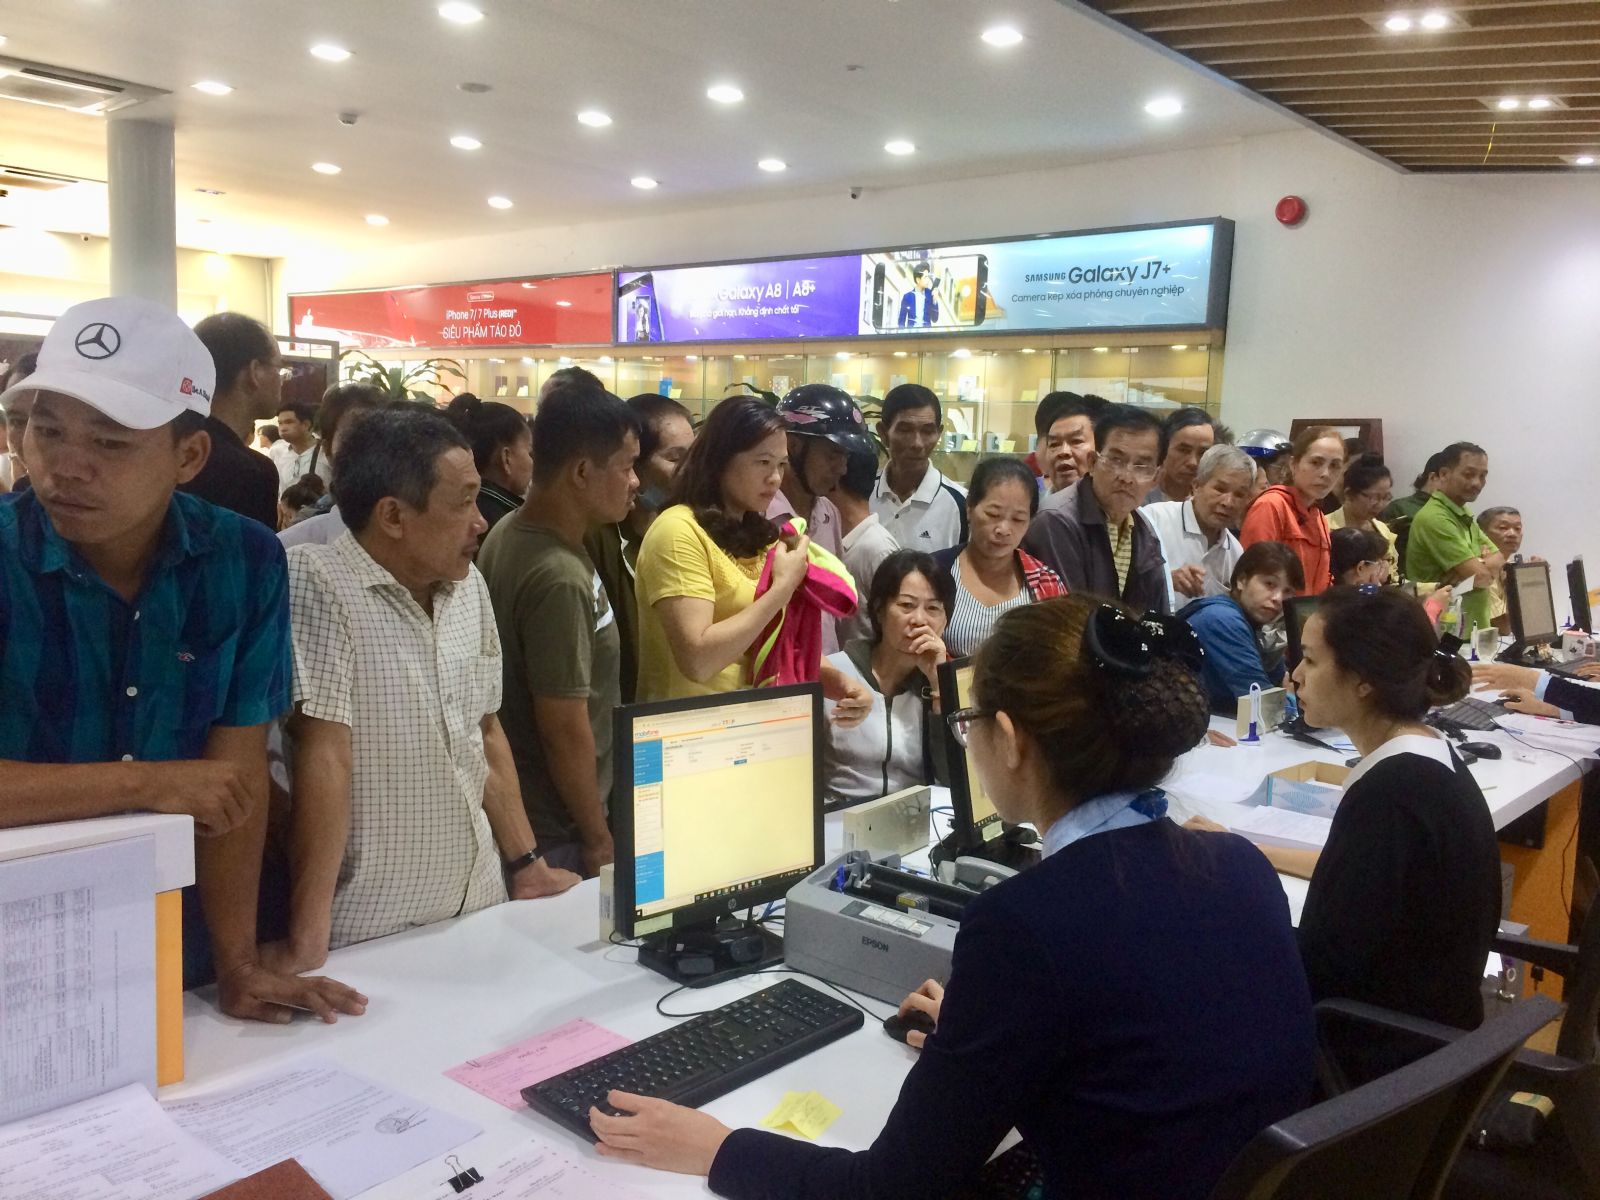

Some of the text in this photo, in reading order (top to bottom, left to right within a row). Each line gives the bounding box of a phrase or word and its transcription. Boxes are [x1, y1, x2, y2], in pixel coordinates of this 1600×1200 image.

[1024, 261, 1171, 286] SAMSUNG Galaxy J7+
[765, 282, 782, 299] A8
[792, 281, 816, 298] A8+
[1011, 294, 1046, 303] Camera
[1065, 289, 1082, 300] xóa
[1150, 284, 1185, 297] nghiệp
[446, 309, 469, 320] iPhone
[483, 307, 498, 319] Plus
[442, 320, 522, 339] SIÊU PHẨM TÁO ĐỎ
[861, 935, 889, 953] EPSON
